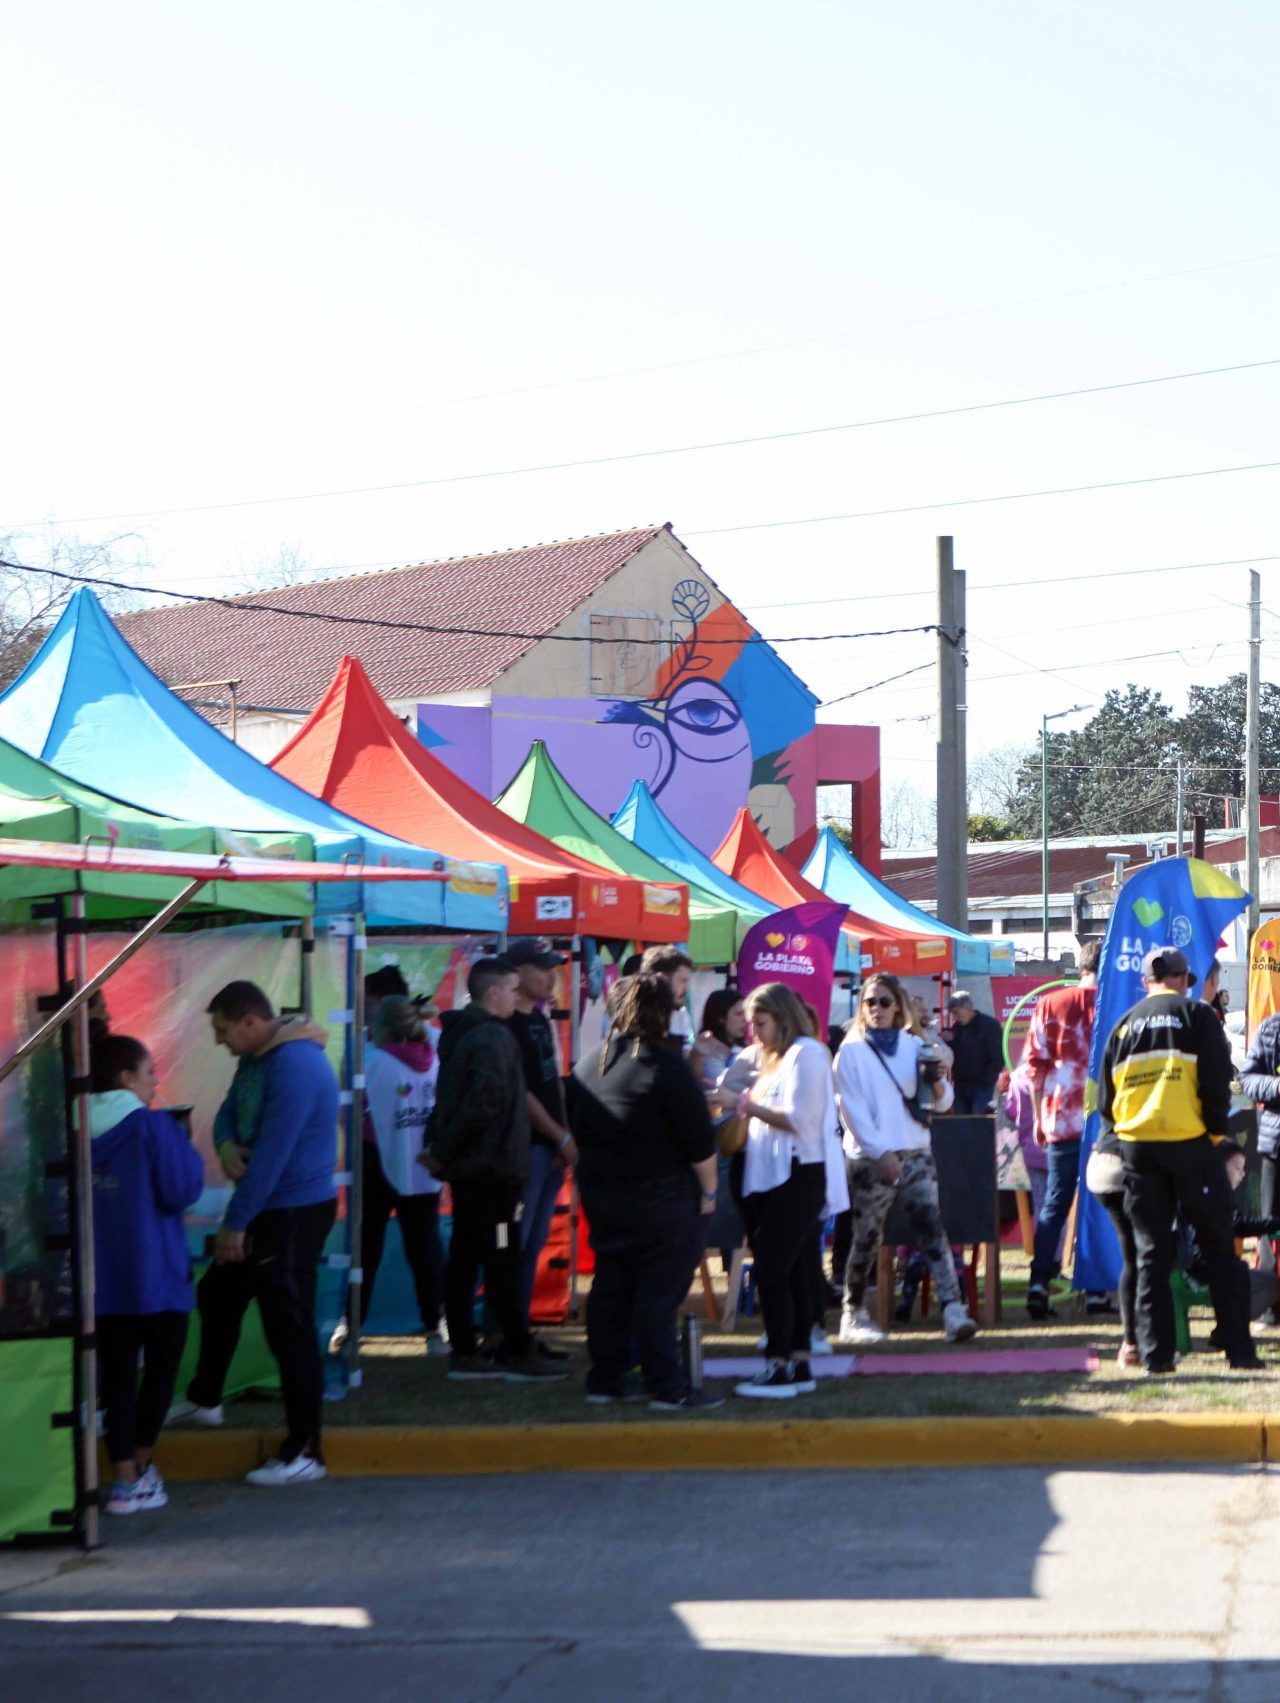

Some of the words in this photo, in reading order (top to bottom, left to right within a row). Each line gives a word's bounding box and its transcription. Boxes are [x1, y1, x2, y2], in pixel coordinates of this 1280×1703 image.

[1121, 936, 1144, 955] LA
[757, 951, 774, 962] LA
[775, 952, 813, 966] PLATA
[1254, 956, 1266, 964] LA
[753, 960, 815, 975] GOBIERNO
